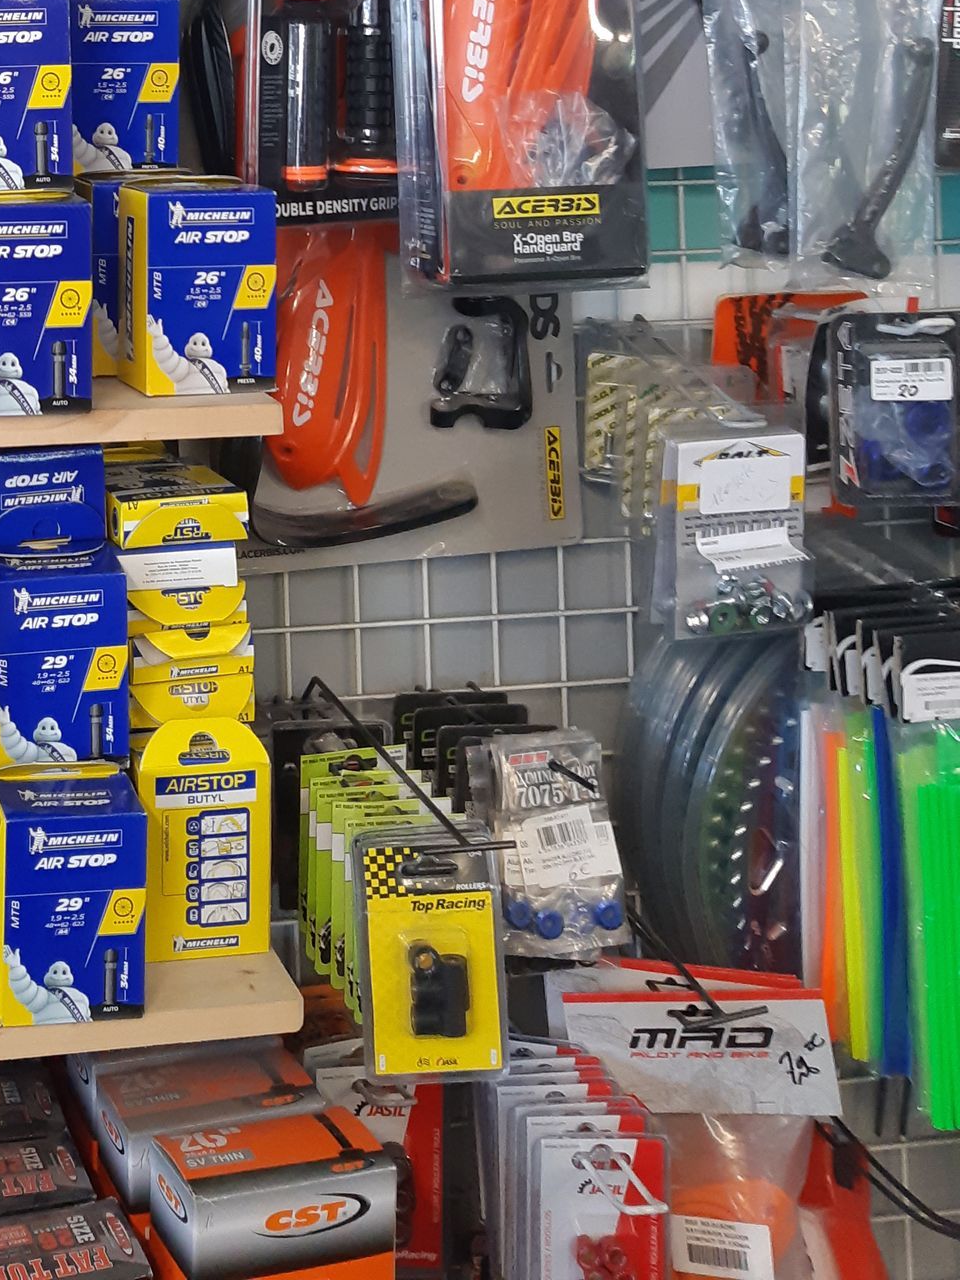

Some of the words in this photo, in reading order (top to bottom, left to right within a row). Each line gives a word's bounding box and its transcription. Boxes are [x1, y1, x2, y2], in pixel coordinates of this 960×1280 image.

[316, 198, 368, 216] DENSITY
[496, 197, 597, 215] ACERBIS
[494, 219, 517, 229] SOUL
[526, 218, 548, 229] AND
[551, 217, 602, 227] PASSION
[513, 232, 558, 246] X-Open
[561, 231, 584, 243] Bre
[13, 244, 63, 258] STOP
[514, 241, 581, 256] Handguard
[292, 279, 333, 426] ACERBIS
[165, 774, 246, 792] AIRSTOP
[187, 794, 225, 805] BUTYL
[34, 855, 66, 871] AIR
[68, 853, 117, 869] STOP
[411, 900, 434, 913] Top
[435, 897, 486, 913] Racing
[629, 1027, 773, 1050] MAD
[367, 1102, 406, 1117] JASIL
[187, 1155, 209, 1168] SV
[212, 1151, 245, 1165] THIN
[2, 1173, 57, 1198] FAT
[264, 1201, 347, 1231] CST
